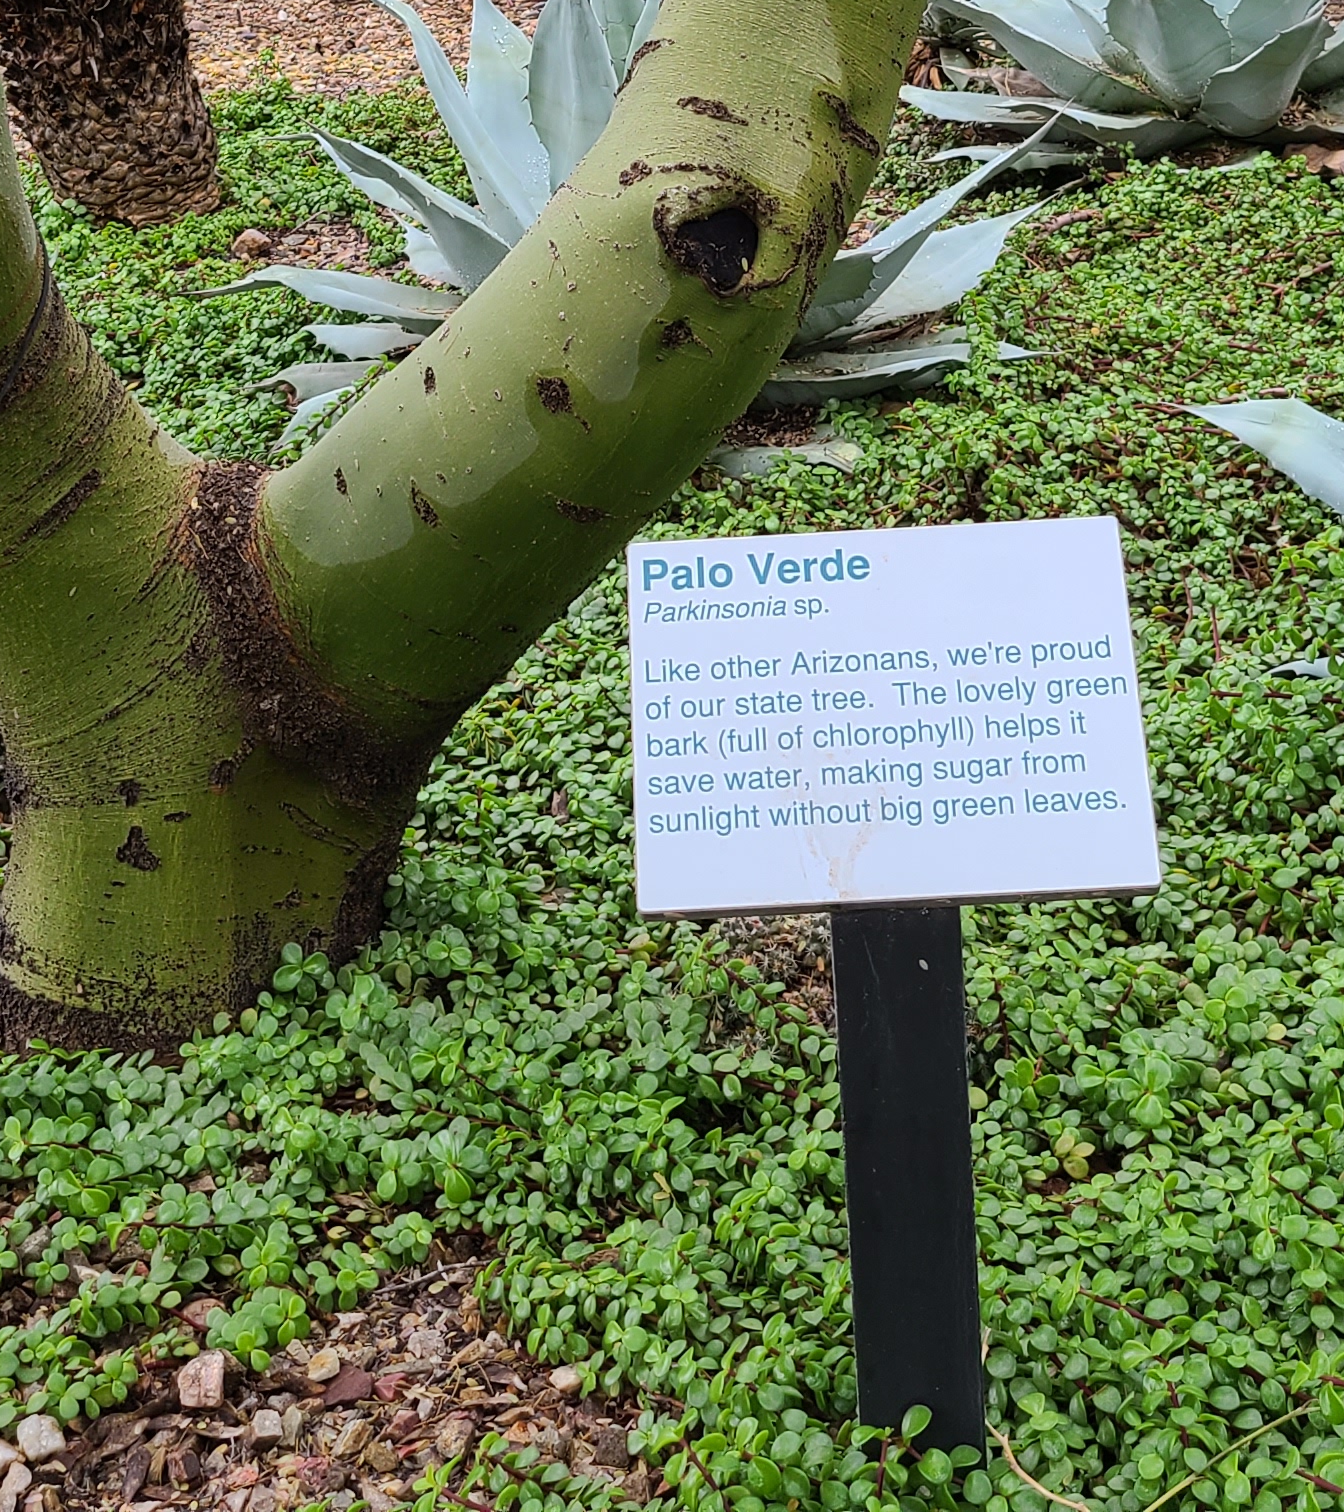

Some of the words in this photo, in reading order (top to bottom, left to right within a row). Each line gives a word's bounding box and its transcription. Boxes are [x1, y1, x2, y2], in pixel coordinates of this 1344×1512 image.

[642, 556, 734, 592] Palo
[746, 548, 871, 585] Verde
[643, 595, 787, 624] Parkinsonia
[793, 598, 829, 620] sp.
[645, 658, 701, 683] Like
[710, 654, 782, 680] other
[790, 649, 938, 676] Arizonans,
[946, 641, 1022, 667] we're
[1031, 634, 1112, 669] proud
[645, 694, 671, 721] of
[680, 697, 726, 719] our
[735, 690, 803, 716] state
[811, 688, 874, 712] tree.
[891, 681, 947, 707] The
[956, 675, 1037, 706] lovely
[1046, 676, 1128, 705] green
[646, 730, 709, 758] bark
[718, 726, 767, 760] (full
[777, 724, 804, 751] of
[812, 715, 974, 751] chlorophyll)
[984, 712, 1061, 744] helps
[1069, 710, 1087, 735] it
[648, 773, 715, 796] save
[723, 766, 810, 791] water,
[821, 757, 923, 788] making
[933, 757, 1013, 785] sugar
[1020, 750, 1086, 775] from
[649, 803, 761, 837] sunlight
[768, 798, 872, 827] without
[880, 795, 923, 827] big
[932, 795, 1015, 825] green
[1024, 788, 1127, 814] leaves.
